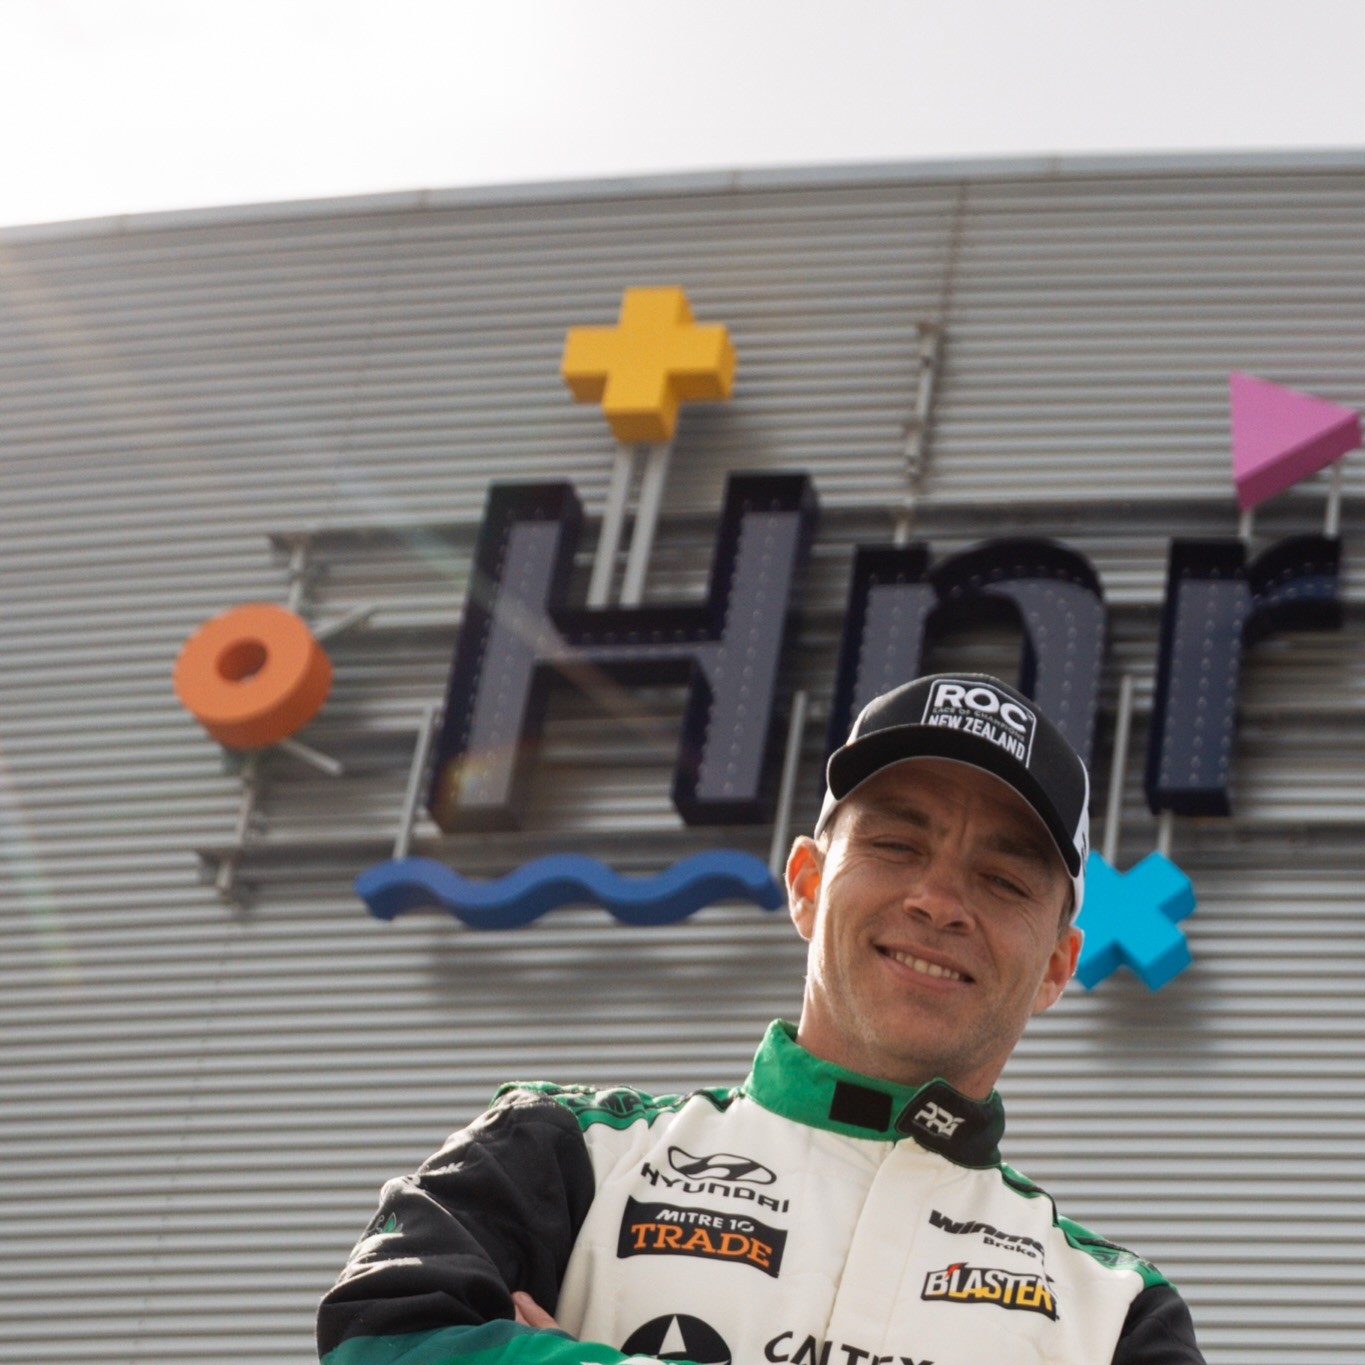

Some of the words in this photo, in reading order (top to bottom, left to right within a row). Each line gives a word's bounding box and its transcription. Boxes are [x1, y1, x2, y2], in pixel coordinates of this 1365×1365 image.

[934, 684, 1027, 733] ROC
[928, 714, 963, 730] NEW
[962, 716, 1026, 761] ZEALAND
[641, 1162, 790, 1214] HYUNDAI
[655, 1208, 724, 1230] MITRE
[729, 1218, 755, 1232] 10
[631, 1224, 772, 1269] TRADE
